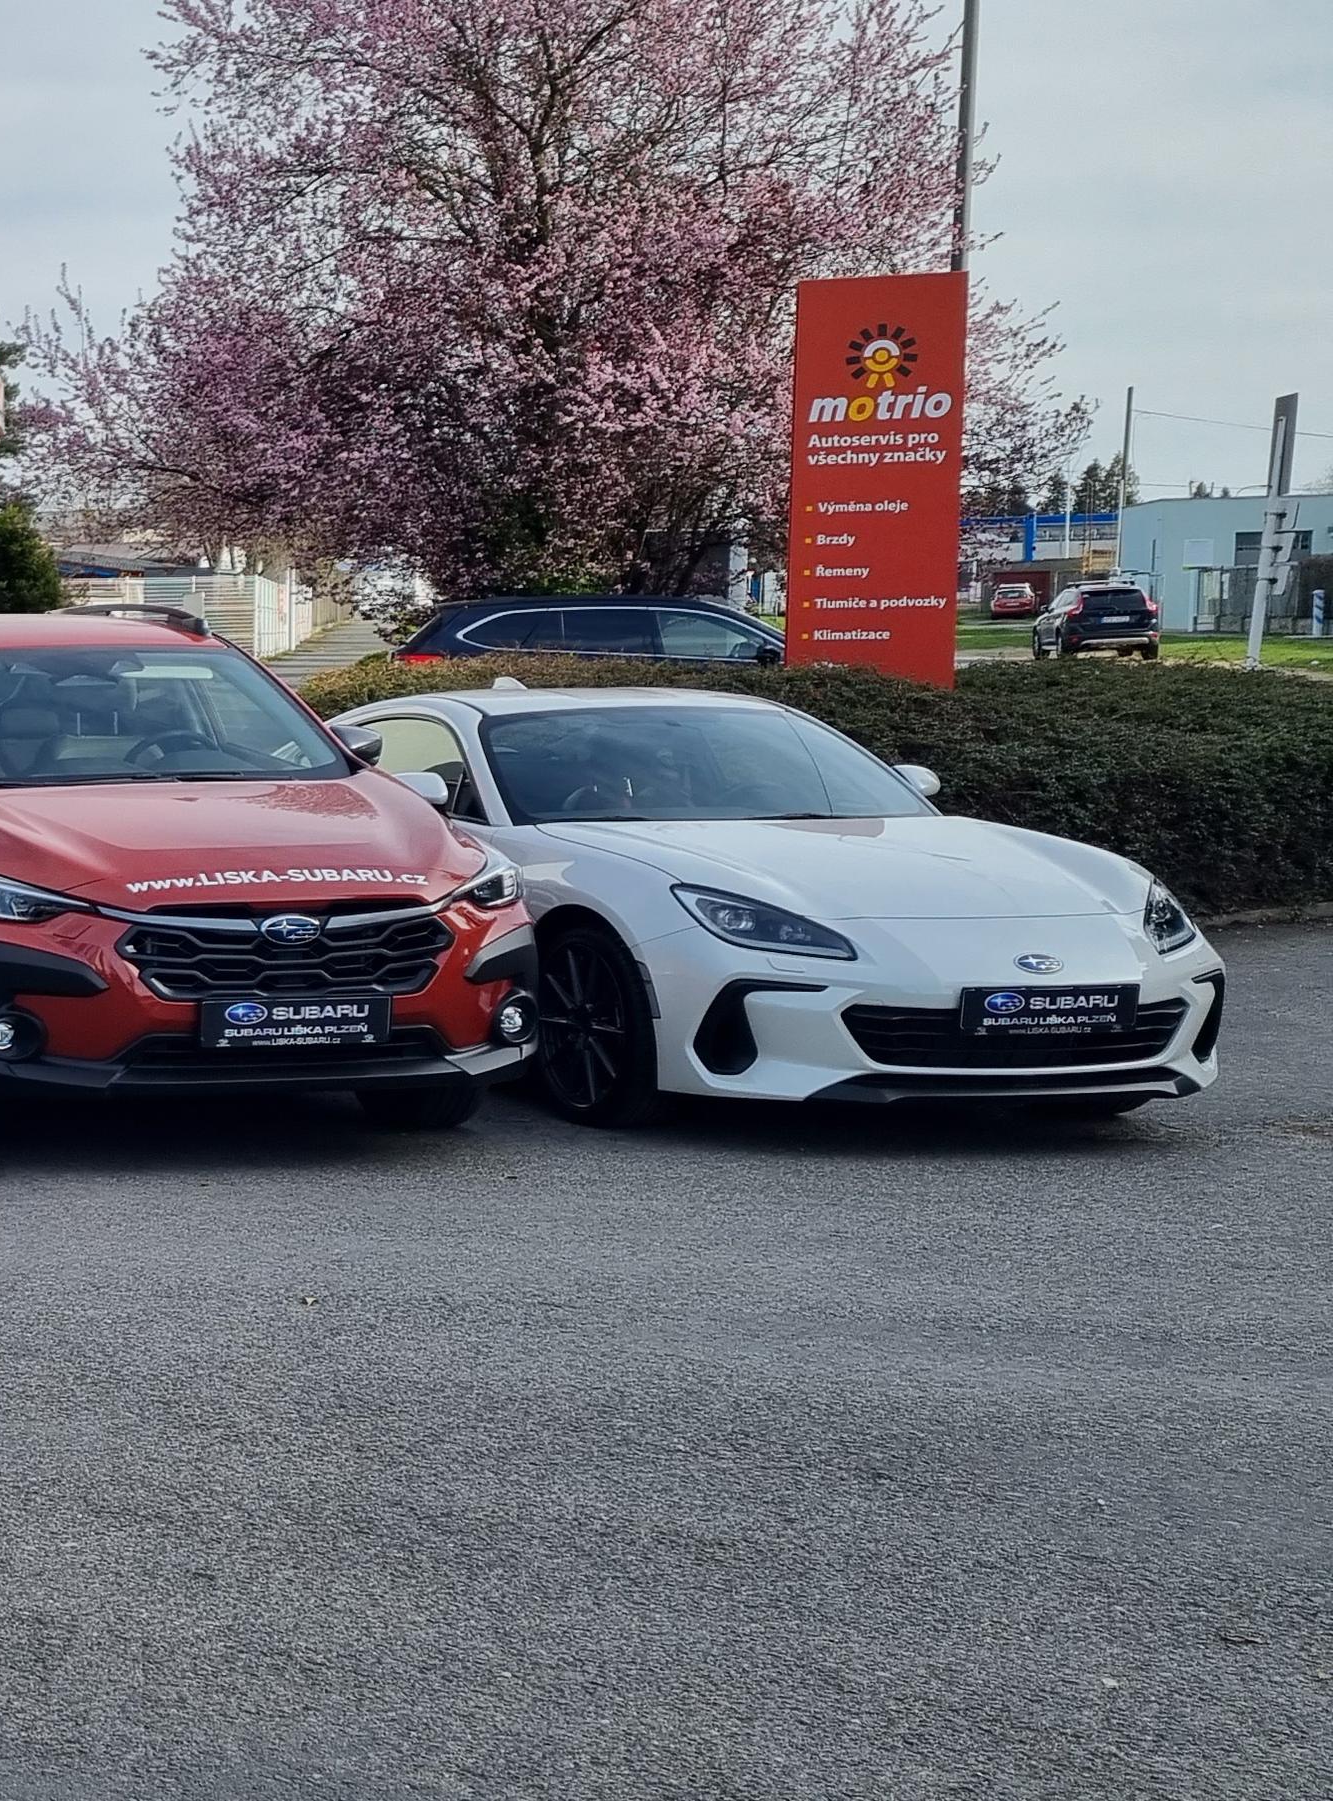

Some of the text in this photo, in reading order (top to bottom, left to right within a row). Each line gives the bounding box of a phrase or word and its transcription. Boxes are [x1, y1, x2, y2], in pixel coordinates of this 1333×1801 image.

[807, 385, 952, 423] motrio
[807, 431, 939, 448] Autoservis pro
[807, 447, 946, 467] všechny značky
[818, 499, 909, 515] Výměna oleje
[816, 533, 855, 547] Brzdy
[815, 564, 870, 579] Řemeny
[814, 596, 947, 610] Tlumiče a podvozky
[813, 629, 891, 641] Klimatizace
[126, 869, 429, 894] www.LISKA-SUBARU.cz
[1029, 995, 1118, 1010] SUBARU
[272, 1004, 369, 1021] SUBARU
[983, 1013, 1117, 1026] SUBARU LIŠKA PLZEŇ
[224, 1023, 368, 1038] SUBARU LIŠKA PLZEŇ
